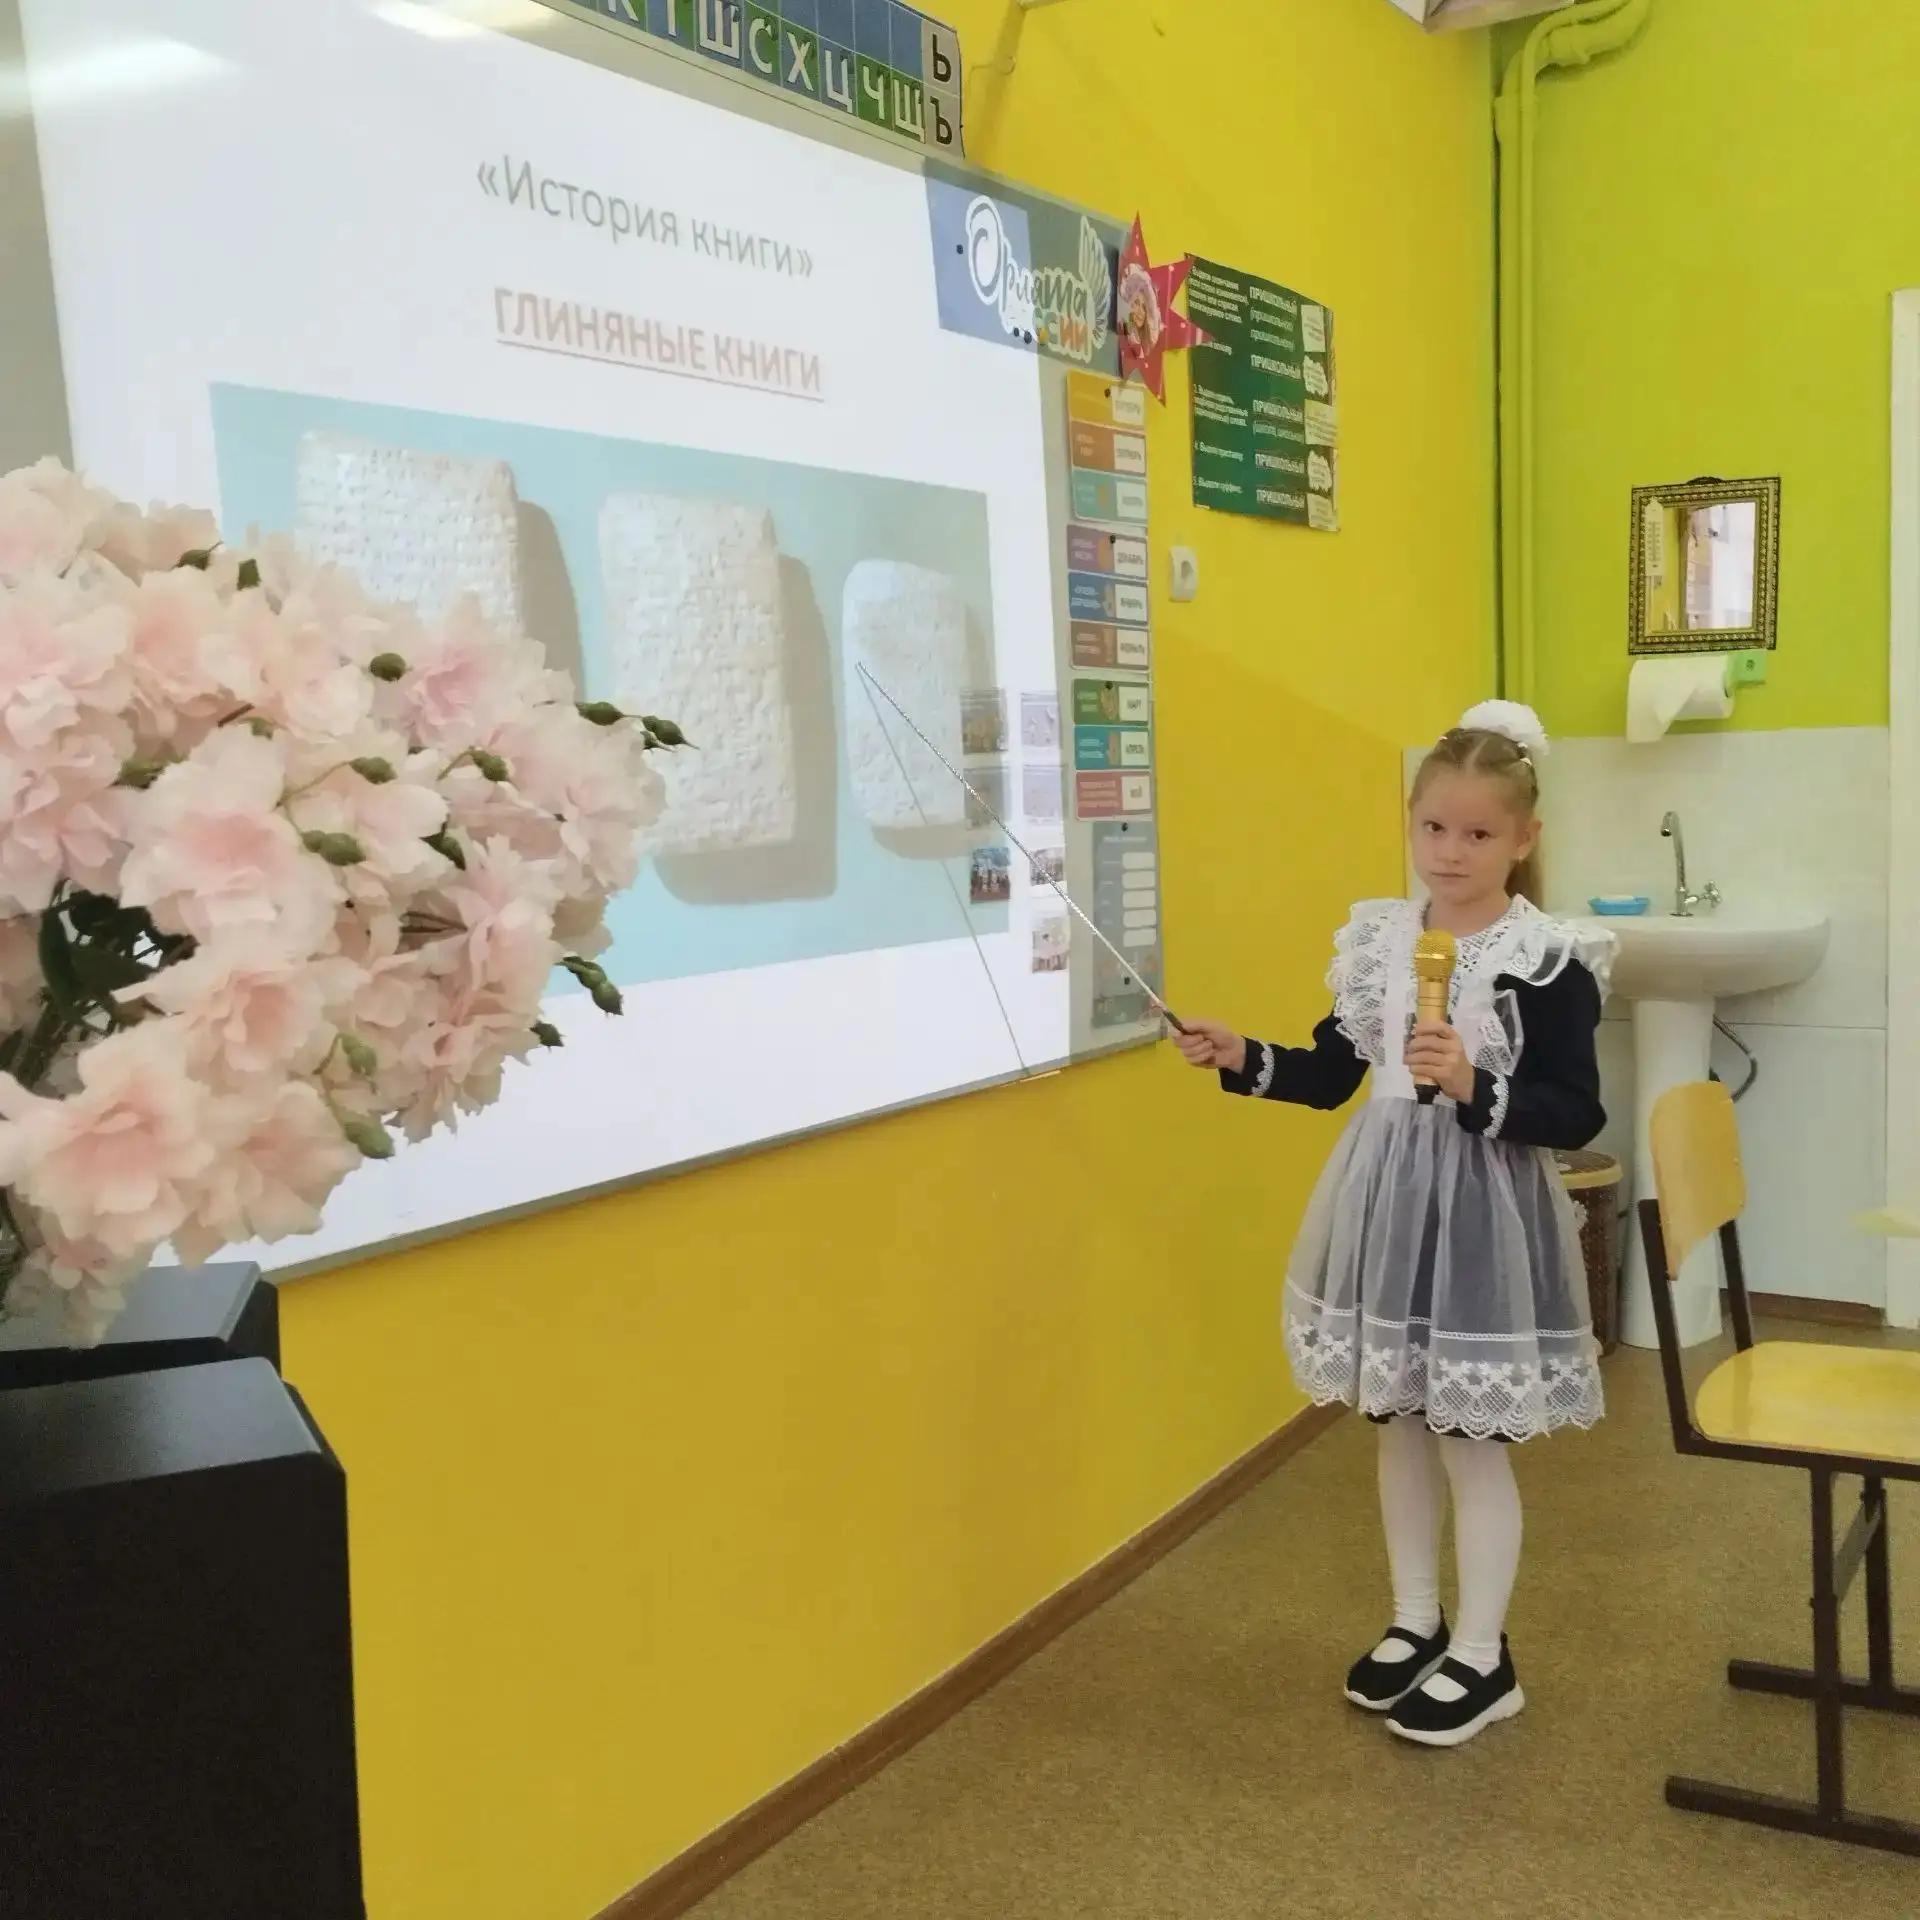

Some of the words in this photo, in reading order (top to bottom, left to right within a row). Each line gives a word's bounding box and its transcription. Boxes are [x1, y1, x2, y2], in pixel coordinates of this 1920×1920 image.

[824, 49, 854, 114] Ц
[862, 64, 886, 120] Ч
[893, 78, 928, 145] Щ
[476, 153, 680, 246] «История
[691, 217, 813, 278] книги»
[494, 285, 708, 373] ГЛИНЯНЫЕ
[713, 332, 822, 393] КНИГИ
